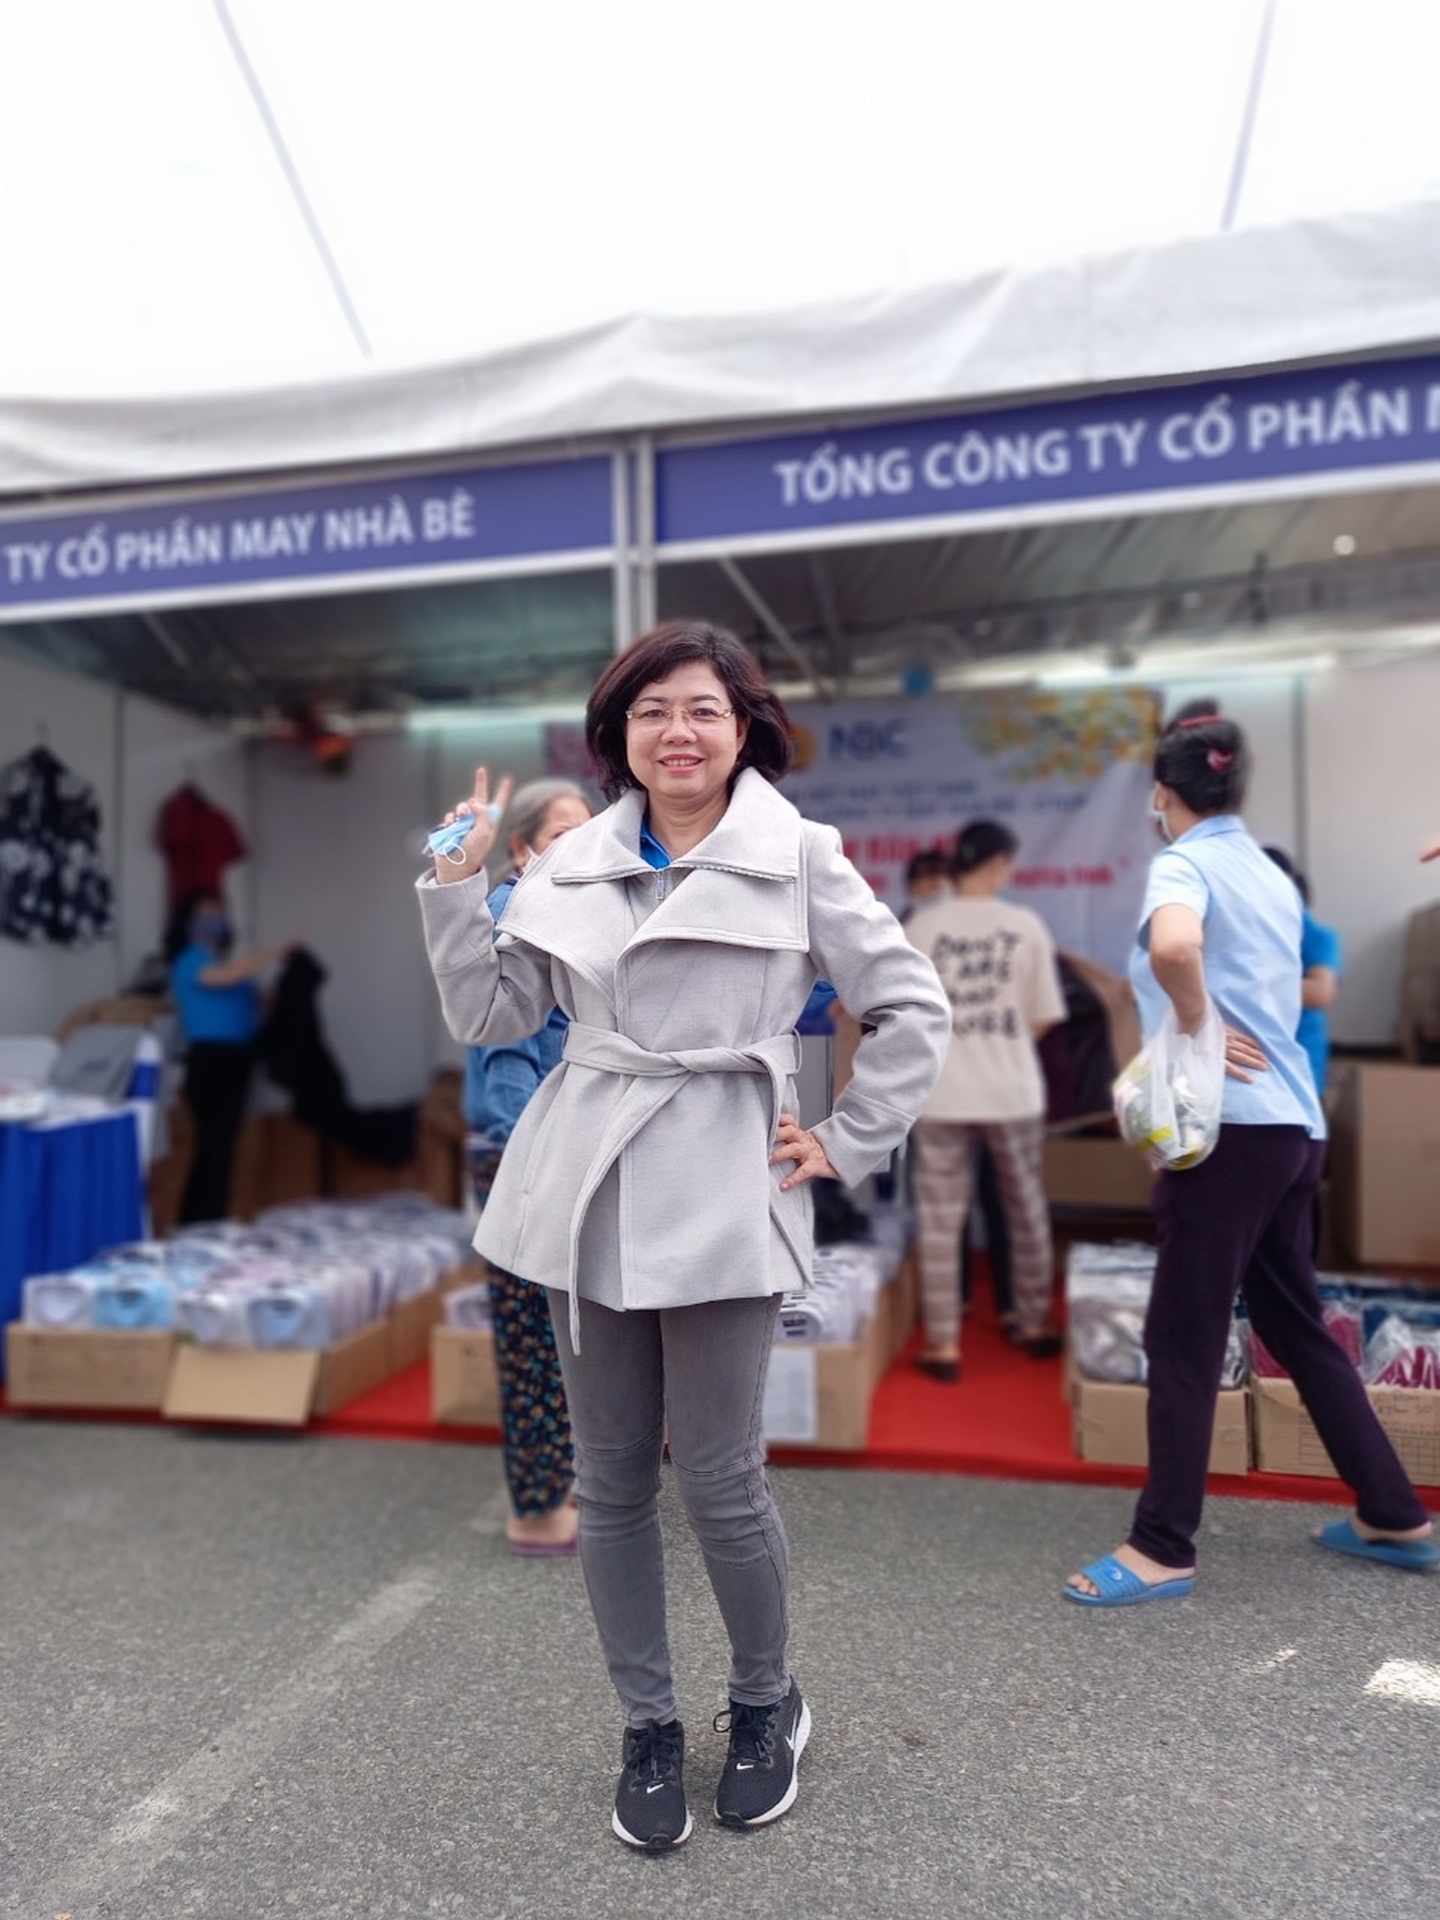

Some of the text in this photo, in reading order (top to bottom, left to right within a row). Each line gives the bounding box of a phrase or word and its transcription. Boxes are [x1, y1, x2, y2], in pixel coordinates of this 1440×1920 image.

[773, 440, 914, 506] TỔNG
[923, 429, 1070, 490] CÔNG
[1078, 417, 1148, 471] TY
[1158, 391, 1236, 462] CỔ
[1248, 378, 1410, 453] PHẦN
[6, 541, 51, 583] TY
[55, 520, 109, 578] CỔ
[229, 510, 317, 561] MAY
[324, 493, 415, 553] NHÀ
[421, 486, 476, 542] BÈ
